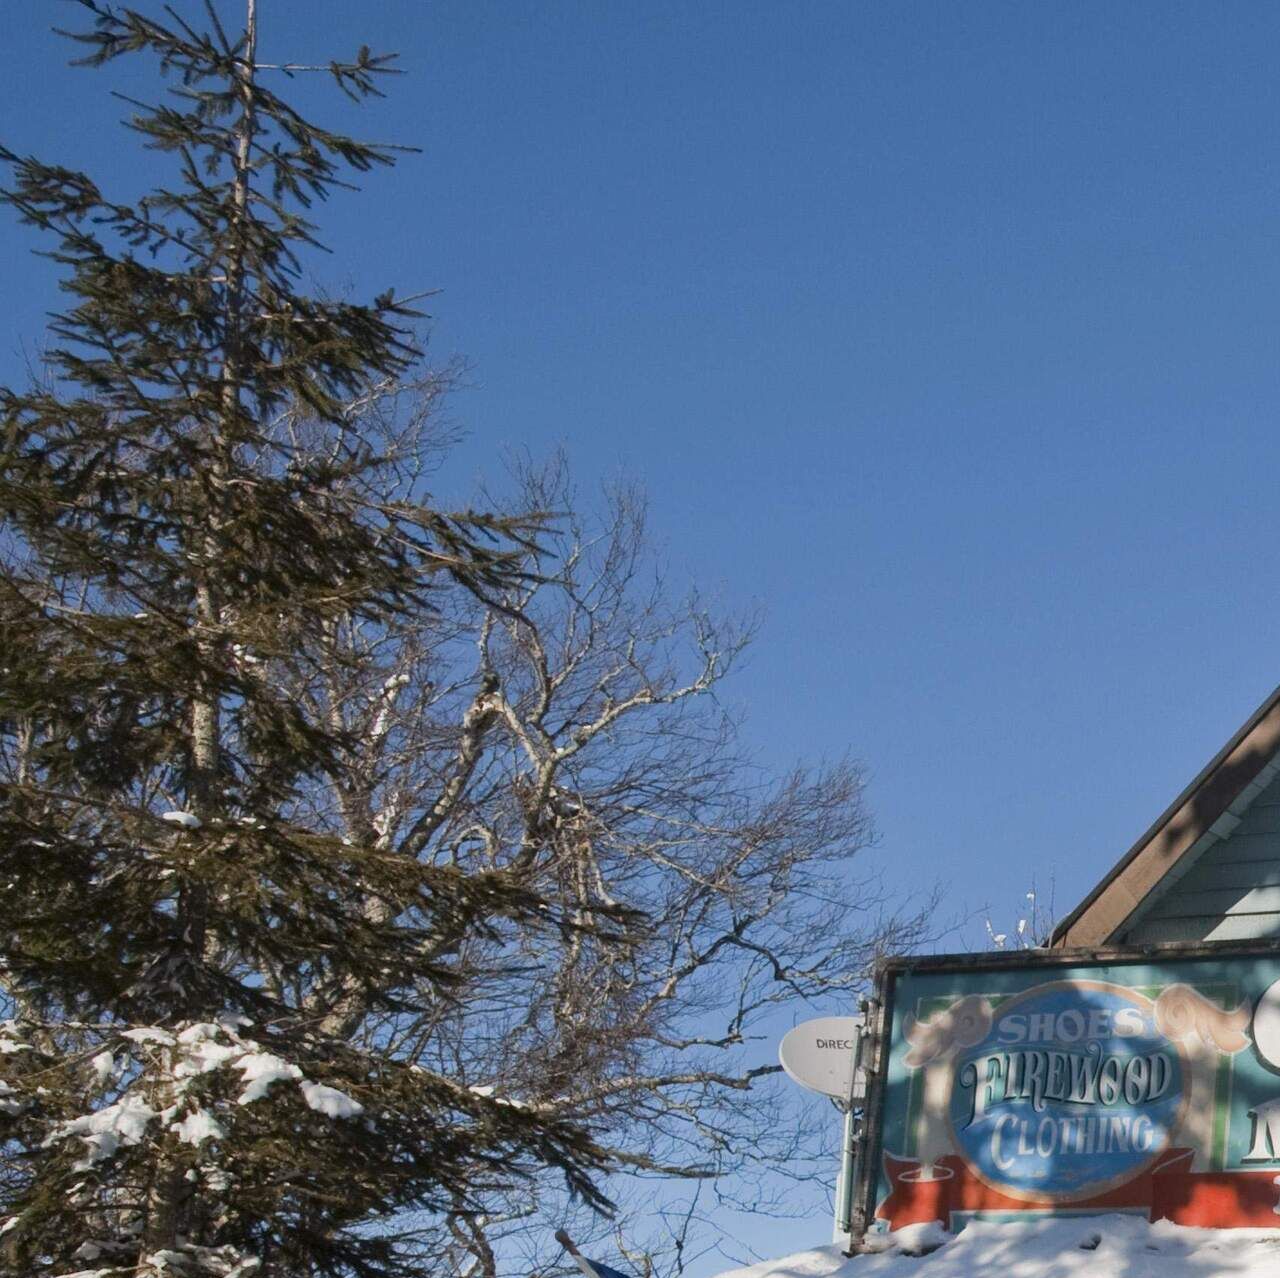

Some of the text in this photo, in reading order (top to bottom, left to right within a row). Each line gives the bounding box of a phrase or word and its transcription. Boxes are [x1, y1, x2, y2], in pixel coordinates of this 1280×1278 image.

[997, 1006, 1149, 1044] SHOES
[960, 1042, 1173, 1131] FIREWOOD
[990, 1109, 1155, 1171] CLOTHING
